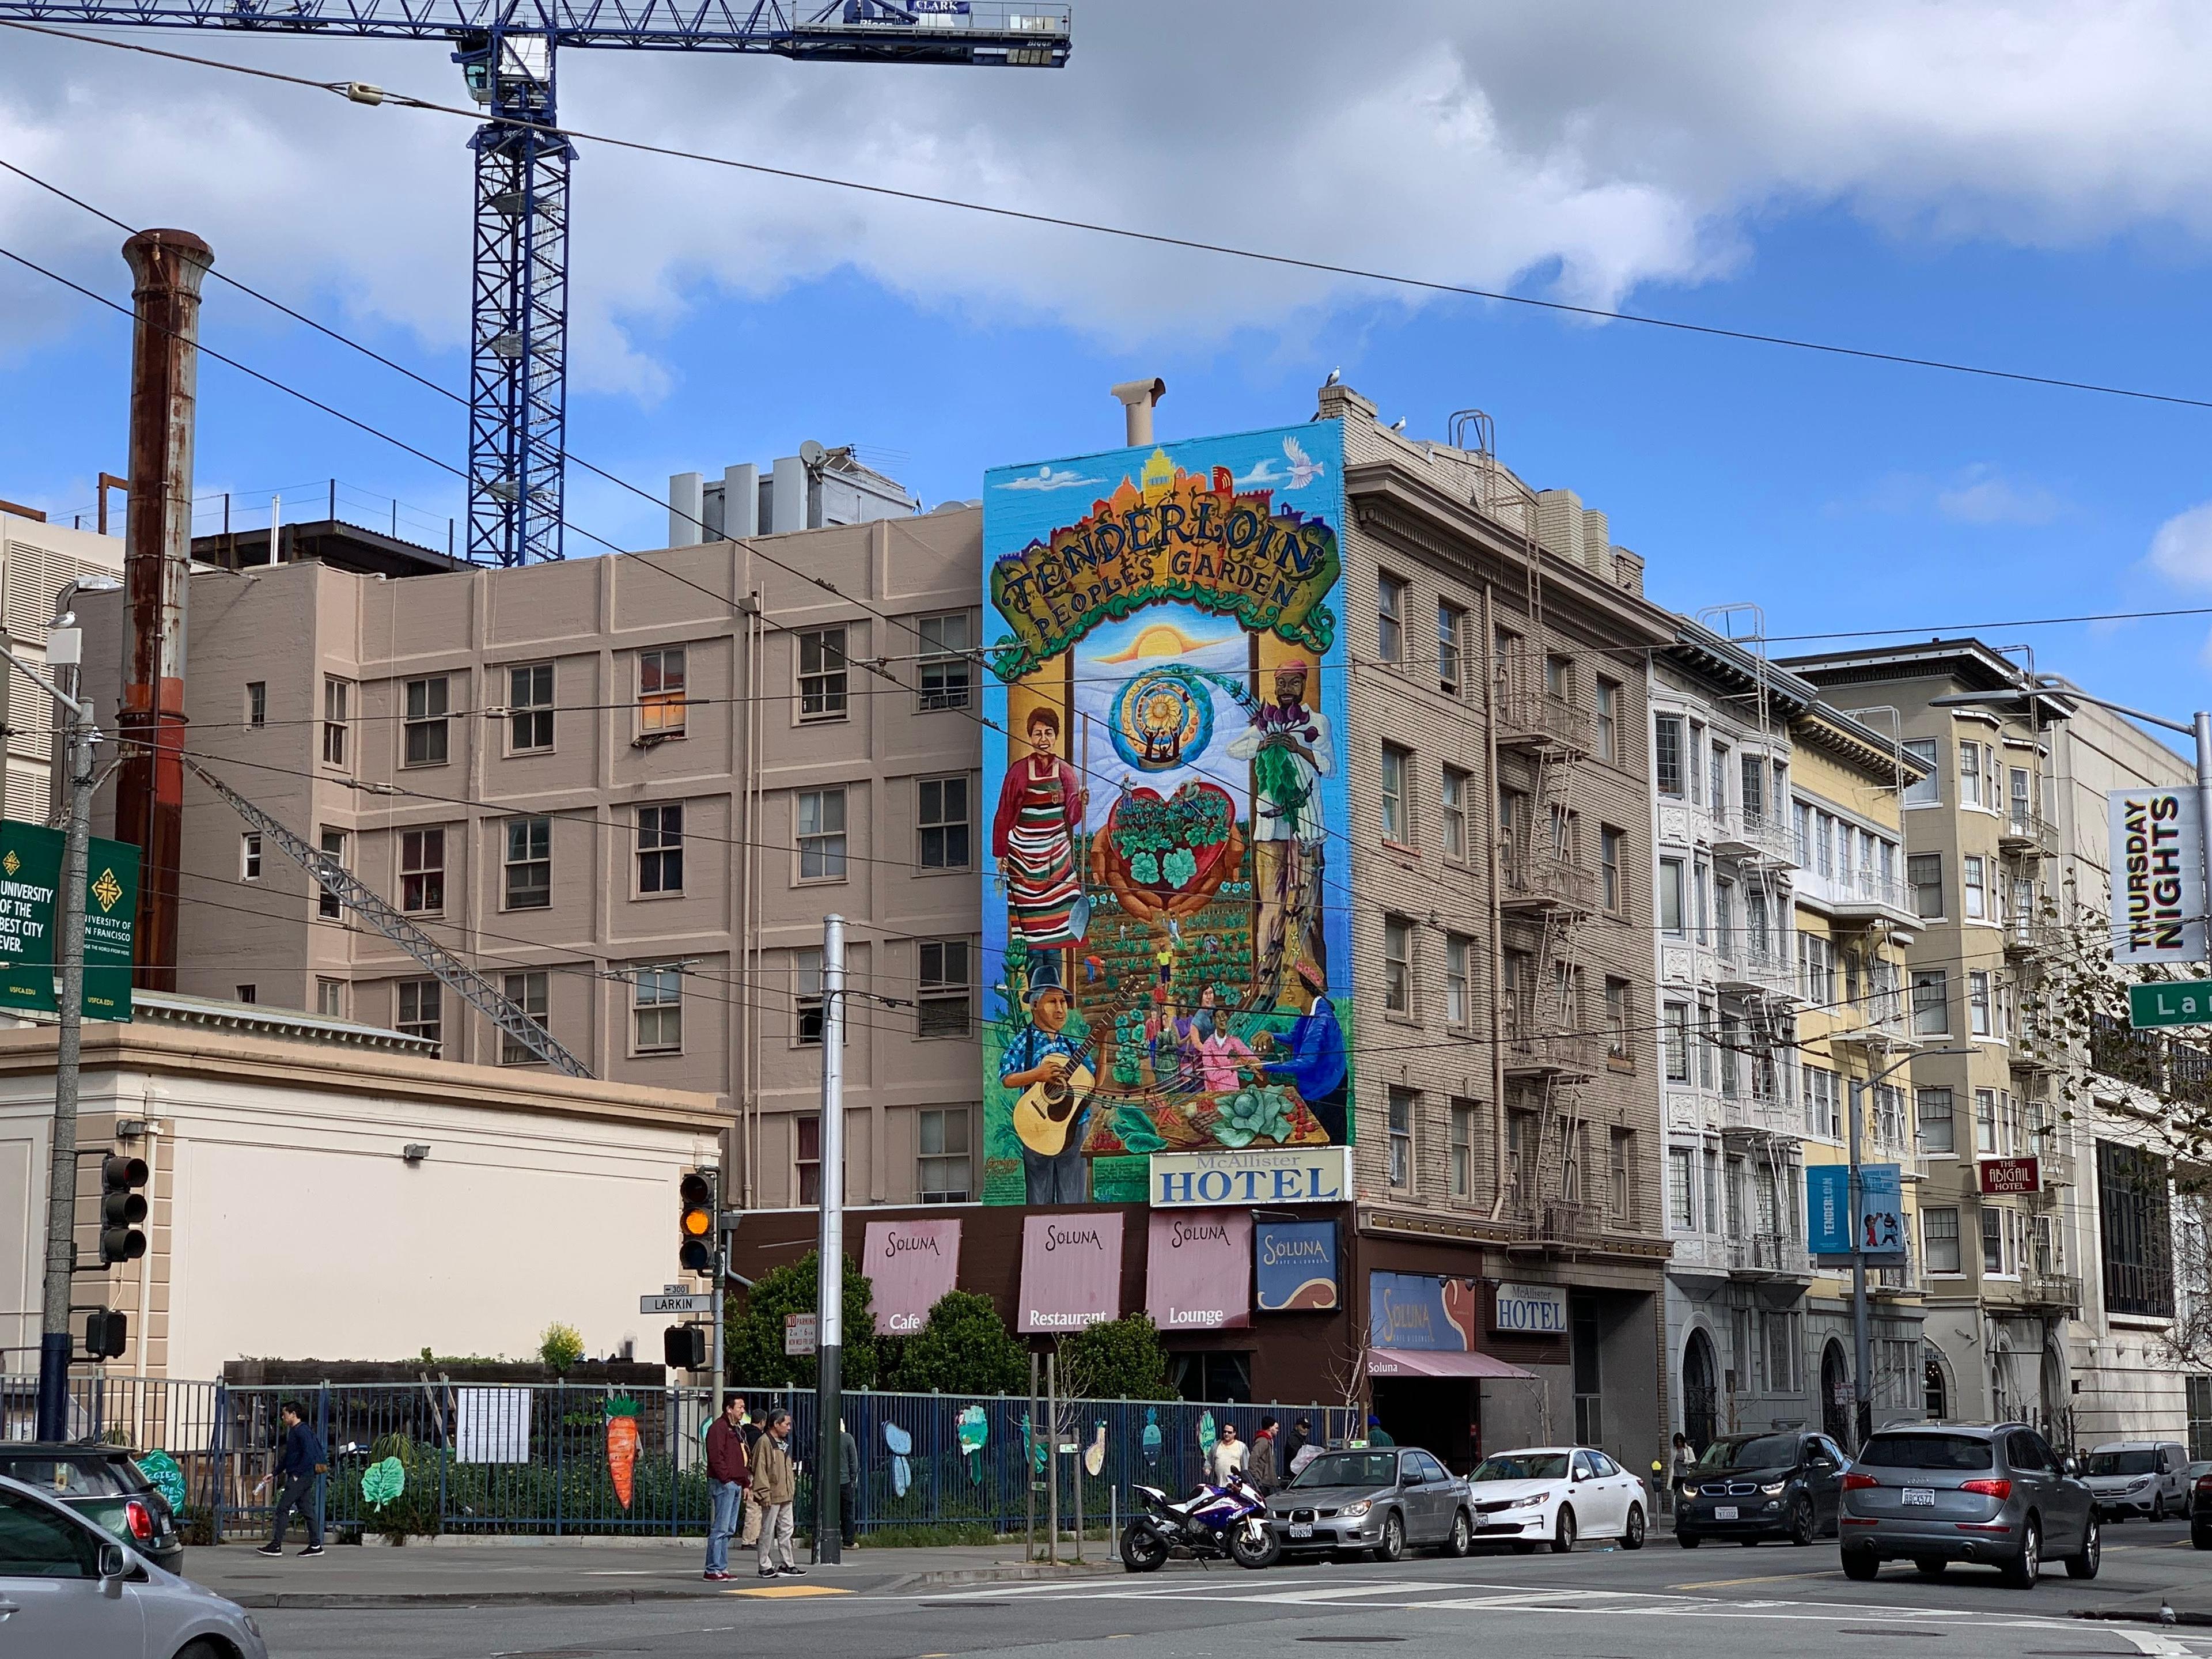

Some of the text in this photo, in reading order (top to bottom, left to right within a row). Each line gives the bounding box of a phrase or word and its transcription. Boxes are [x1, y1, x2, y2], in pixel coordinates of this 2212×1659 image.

[916, 1, 957, 10] CLARK
[1002, 501, 1325, 612] TENDERLOIN
[1033, 550, 1298, 639] PEOPLES GARDEN
[2124, 798, 2152, 953] THURSDAY
[2150, 794, 2184, 950] NIGHTS
[1, 880, 54, 903] UNIVERSITY
[0, 899, 32, 918] OF THE
[0, 916, 44, 938] BEST CITY
[84, 915, 131, 930] IVERSITY OF
[93, 927, 130, 942] FRANCISCO
[9, 986, 36, 995] USFCA.EDU
[88, 997, 114, 1006] USFCA.EDU
[1196, 1154, 1301, 1170] McAllister
[1988, 1168, 2031, 1183] ABIGAIL
[1158, 1168, 1339, 1203] HOTEL
[1995, 1183, 2026, 1191] HOTEL
[1512, 1285, 1552, 1301] McAllister
[654, 1298, 692, 1310] LARKIN
[787, 1316, 796, 1326] NO
[889, 1313, 921, 1330] Cafe
[1029, 1310, 1107, 1326] Restaurant
[1169, 1307, 1223, 1325] Lounge
[1498, 1298, 1565, 1331] HOTEL
[790, 1328, 793, 1336] 2
[1368, 1361, 1398, 1373] Soluna
[158, 1485, 175, 1494] THE
